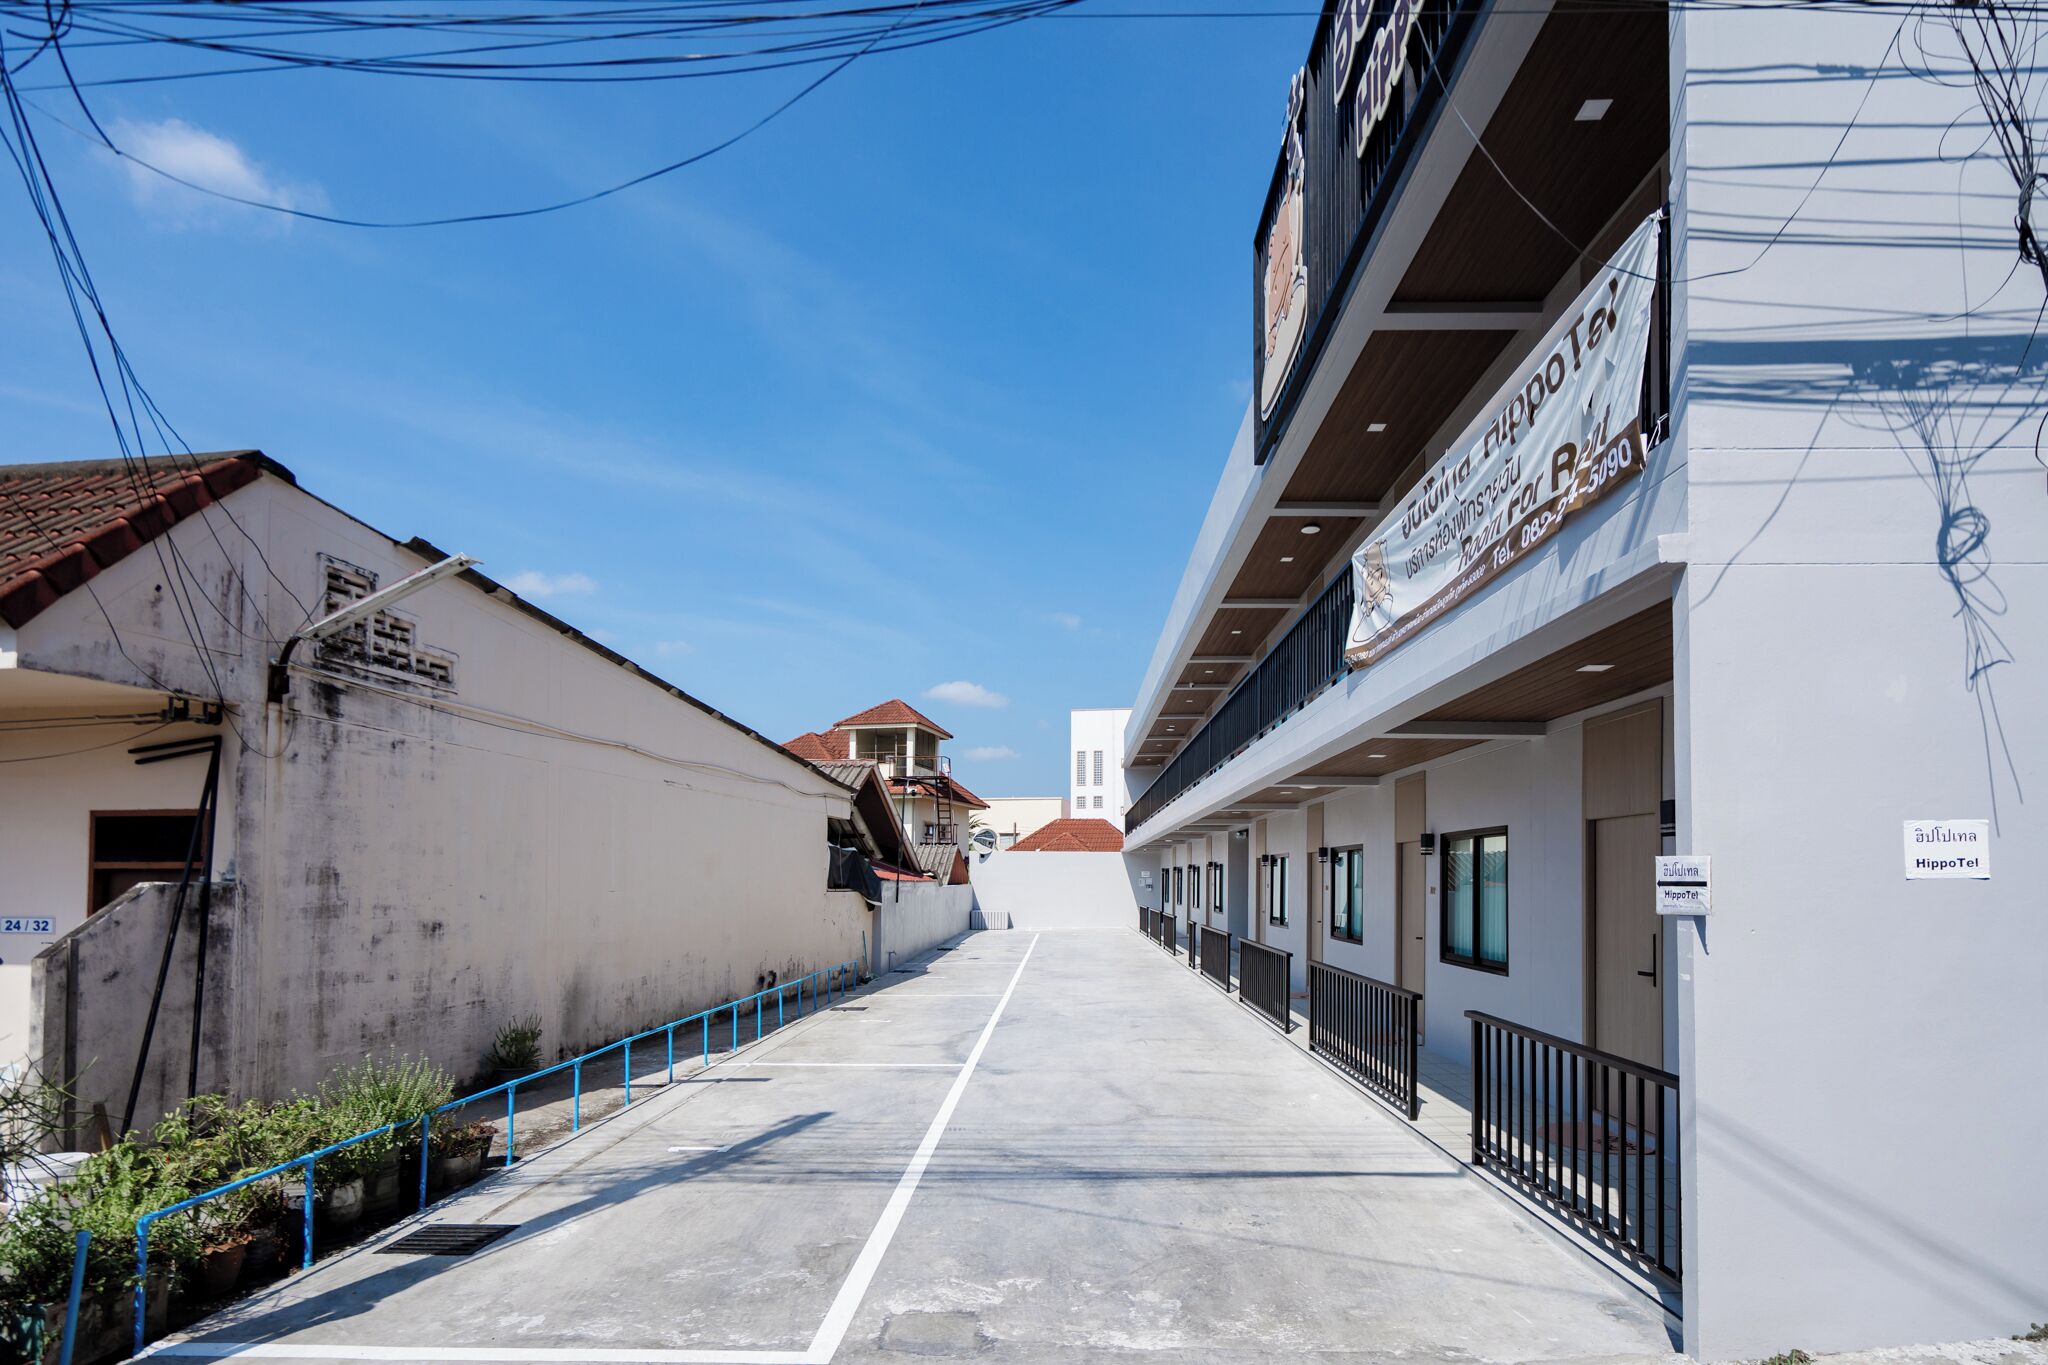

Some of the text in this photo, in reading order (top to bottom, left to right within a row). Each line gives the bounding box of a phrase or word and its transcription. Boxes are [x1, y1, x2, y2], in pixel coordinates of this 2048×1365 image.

[1458, 508, 1504, 572] Room
[1493, 537, 1515, 570] Tel.
[1914, 826, 1977, 843] ฮิปโปเทล
[1663, 861, 1699, 877] ฮิปโปเทล
[1916, 858, 1979, 871] HippoTel
[1664, 890, 1699, 901] HippoTel
